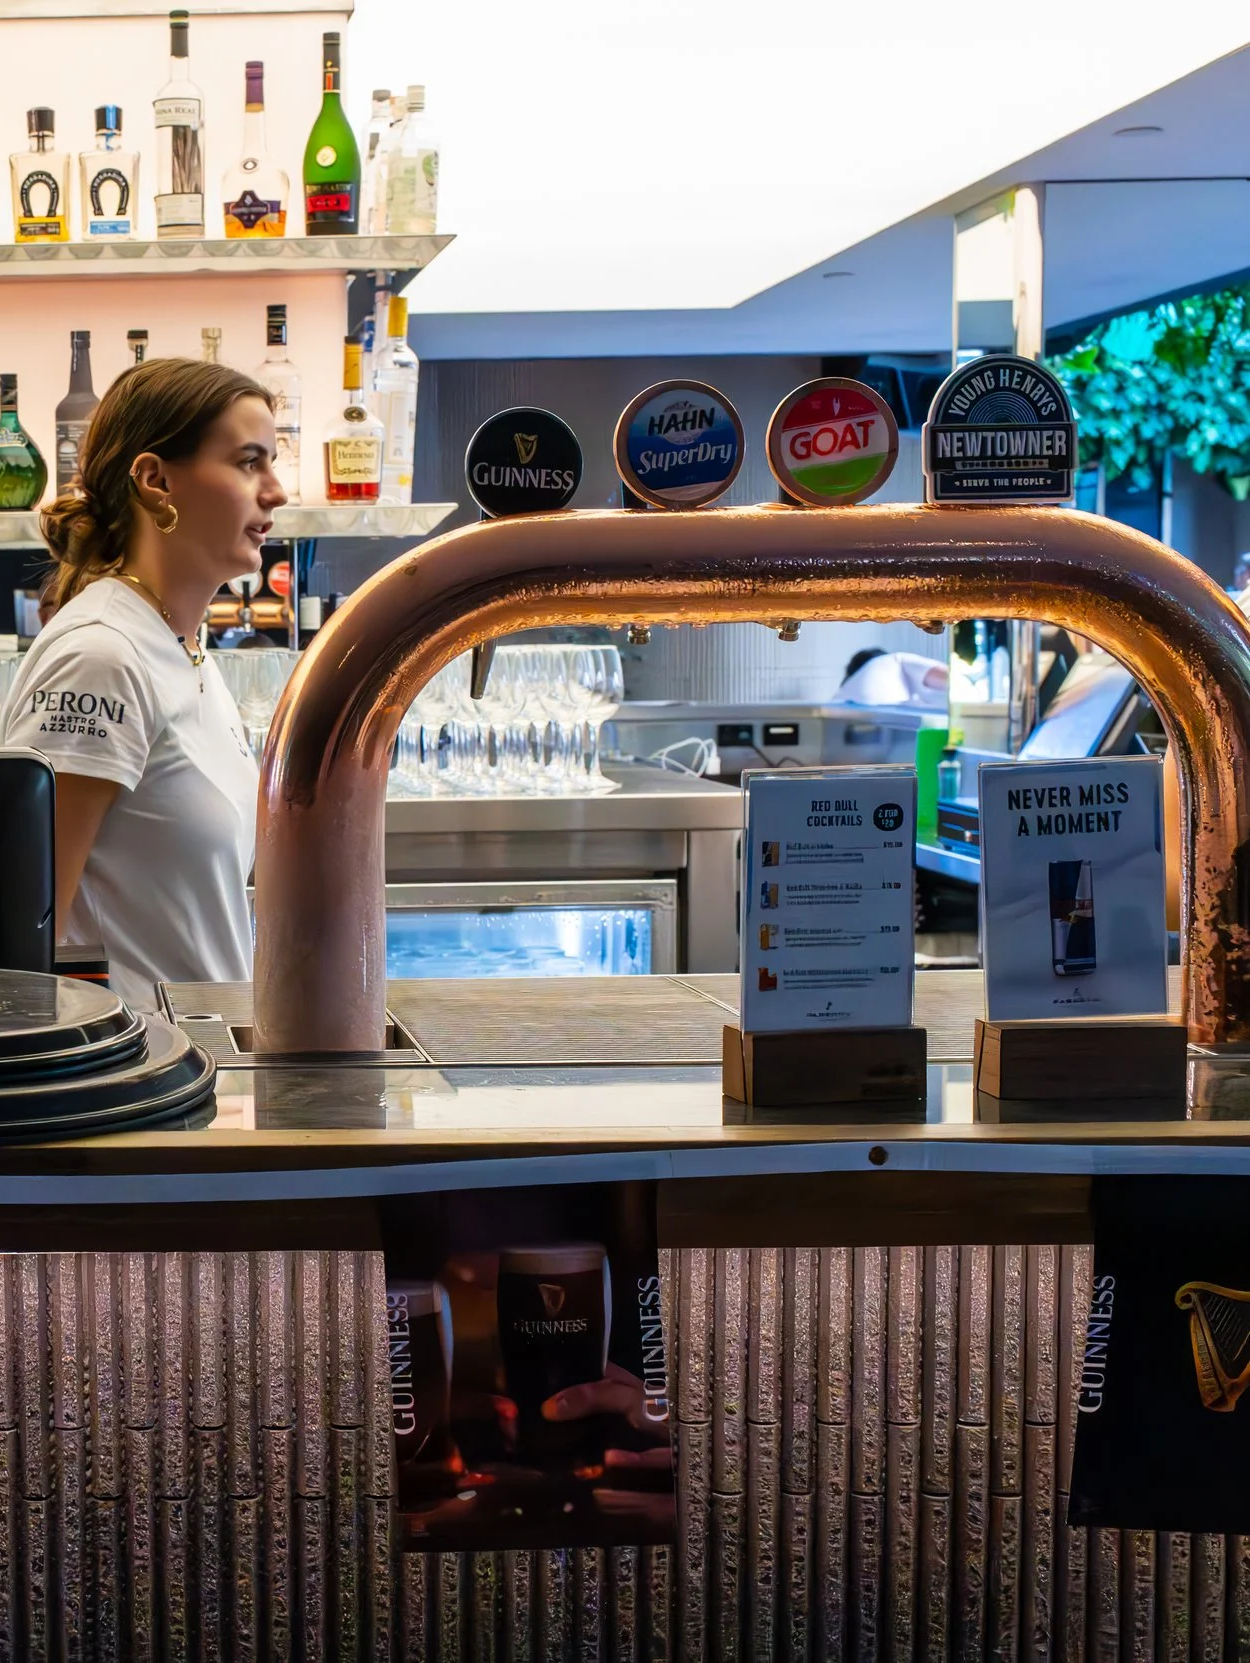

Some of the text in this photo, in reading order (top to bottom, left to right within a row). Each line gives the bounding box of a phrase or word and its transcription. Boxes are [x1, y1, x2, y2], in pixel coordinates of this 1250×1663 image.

[949, 368, 1057, 416] YOUNG HENRYS
[648, 407, 715, 437] HAHN
[790, 419, 875, 460] GOAT
[937, 430, 1067, 458] NEWTOWNER
[472, 461, 574, 499] GUINNESS
[31, 690, 126, 724] PERONI
[50, 714, 96, 726] NASTRO
[39, 722, 108, 738] AZZURRO
[1007, 782, 1129, 811] NEVER MISS
[1017, 810, 1122, 836] A MOMENT
[637, 1275, 670, 1422] GUINNESS
[1077, 1275, 1116, 1413] GUINNESS
[386, 1293, 416, 1435] GUINNESS
